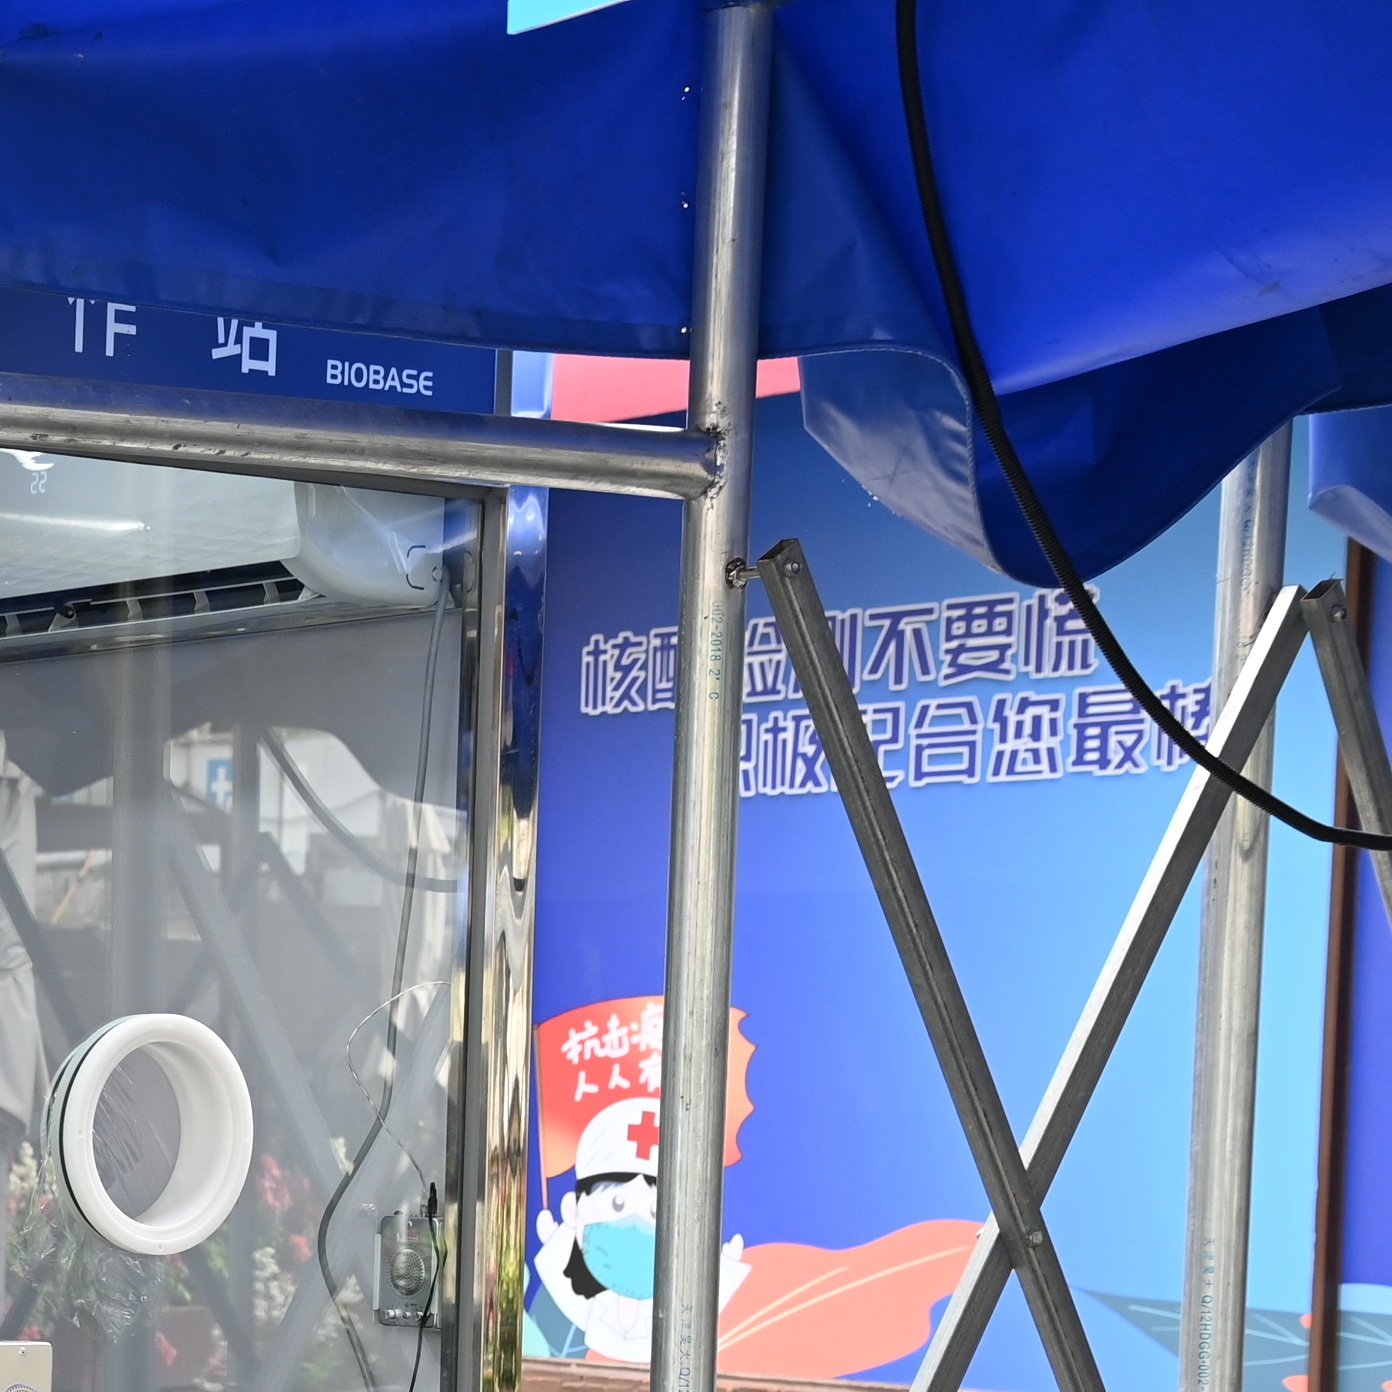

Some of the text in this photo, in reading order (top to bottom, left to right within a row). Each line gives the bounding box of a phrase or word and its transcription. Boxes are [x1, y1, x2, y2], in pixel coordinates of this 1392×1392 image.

[326, 358, 434, 397] BIOBASE
[740, 678, 1212, 798] 极合您最
